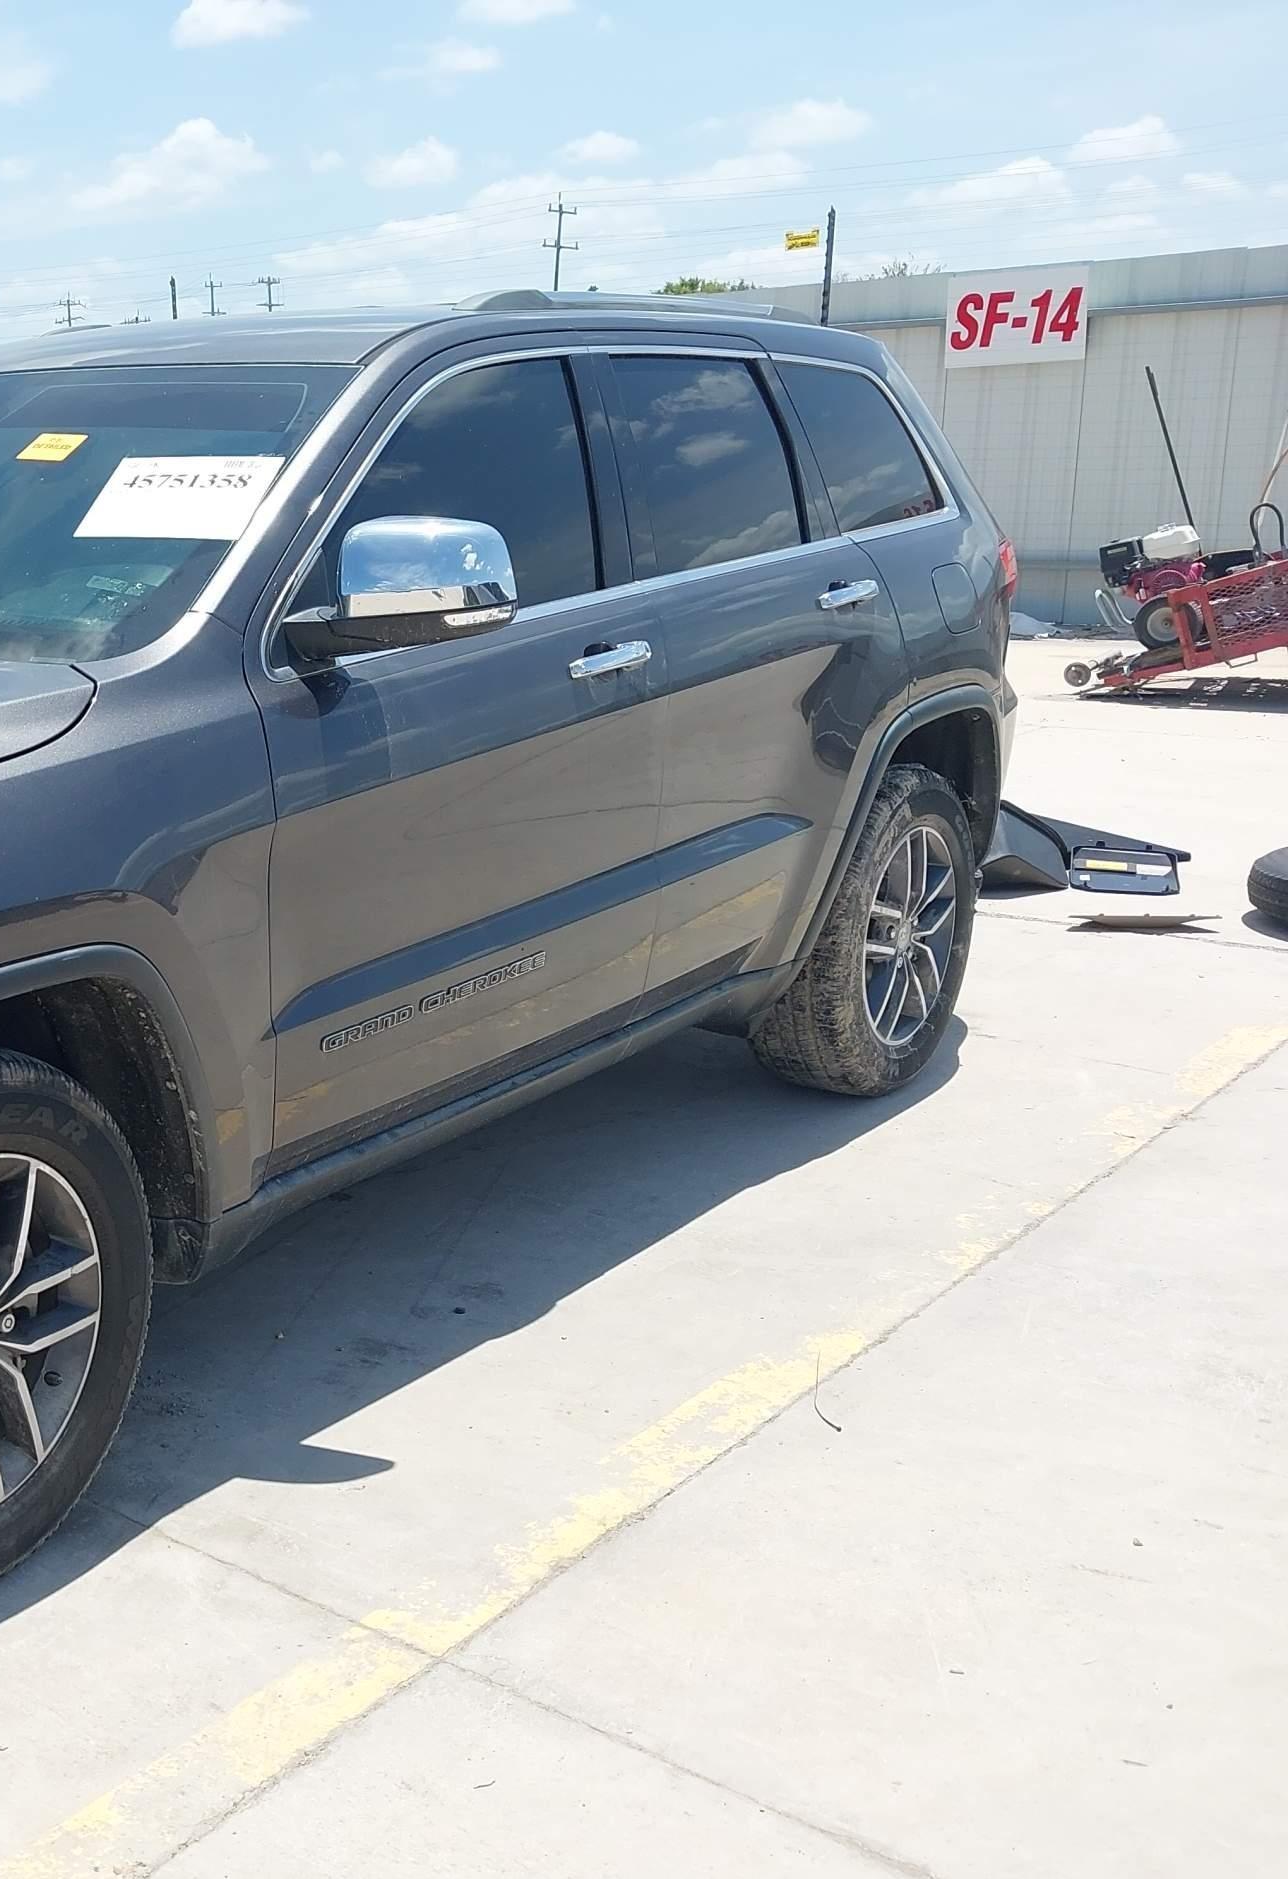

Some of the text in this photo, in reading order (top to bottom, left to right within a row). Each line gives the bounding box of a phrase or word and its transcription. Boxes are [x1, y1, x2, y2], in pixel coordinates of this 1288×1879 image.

[949, 285, 1085, 351] SF-14
[123, 473, 253, 489] 45751358
[321, 950, 547, 1053] GRAND CHEROKEE
